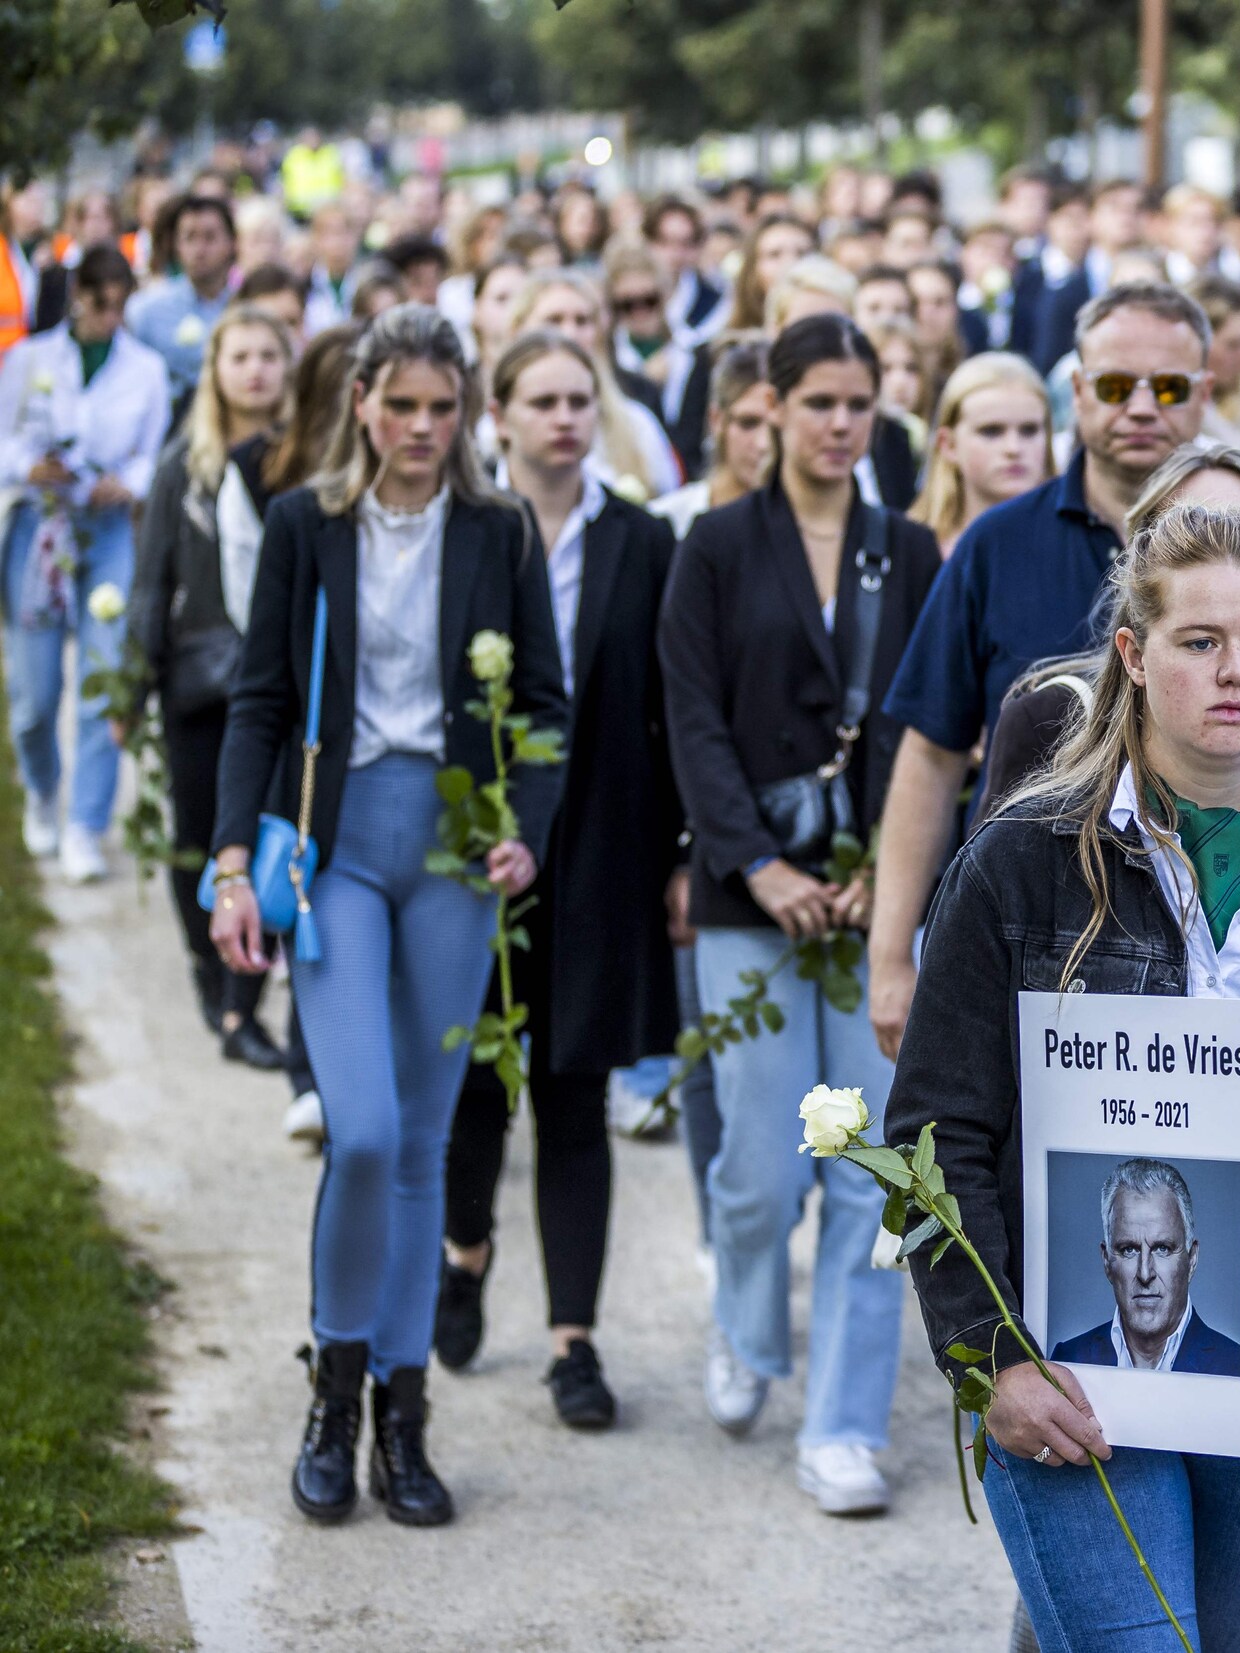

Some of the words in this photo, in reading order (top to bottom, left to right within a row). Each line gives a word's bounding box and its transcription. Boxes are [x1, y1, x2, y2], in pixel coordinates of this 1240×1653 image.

[1044, 1028, 1108, 1071] Peter
[1115, 1031, 1138, 1072] R.
[1147, 1032, 1176, 1074] de
[1100, 1098, 1136, 1126] 1956
[1154, 1100, 1189, 1129] 2021
